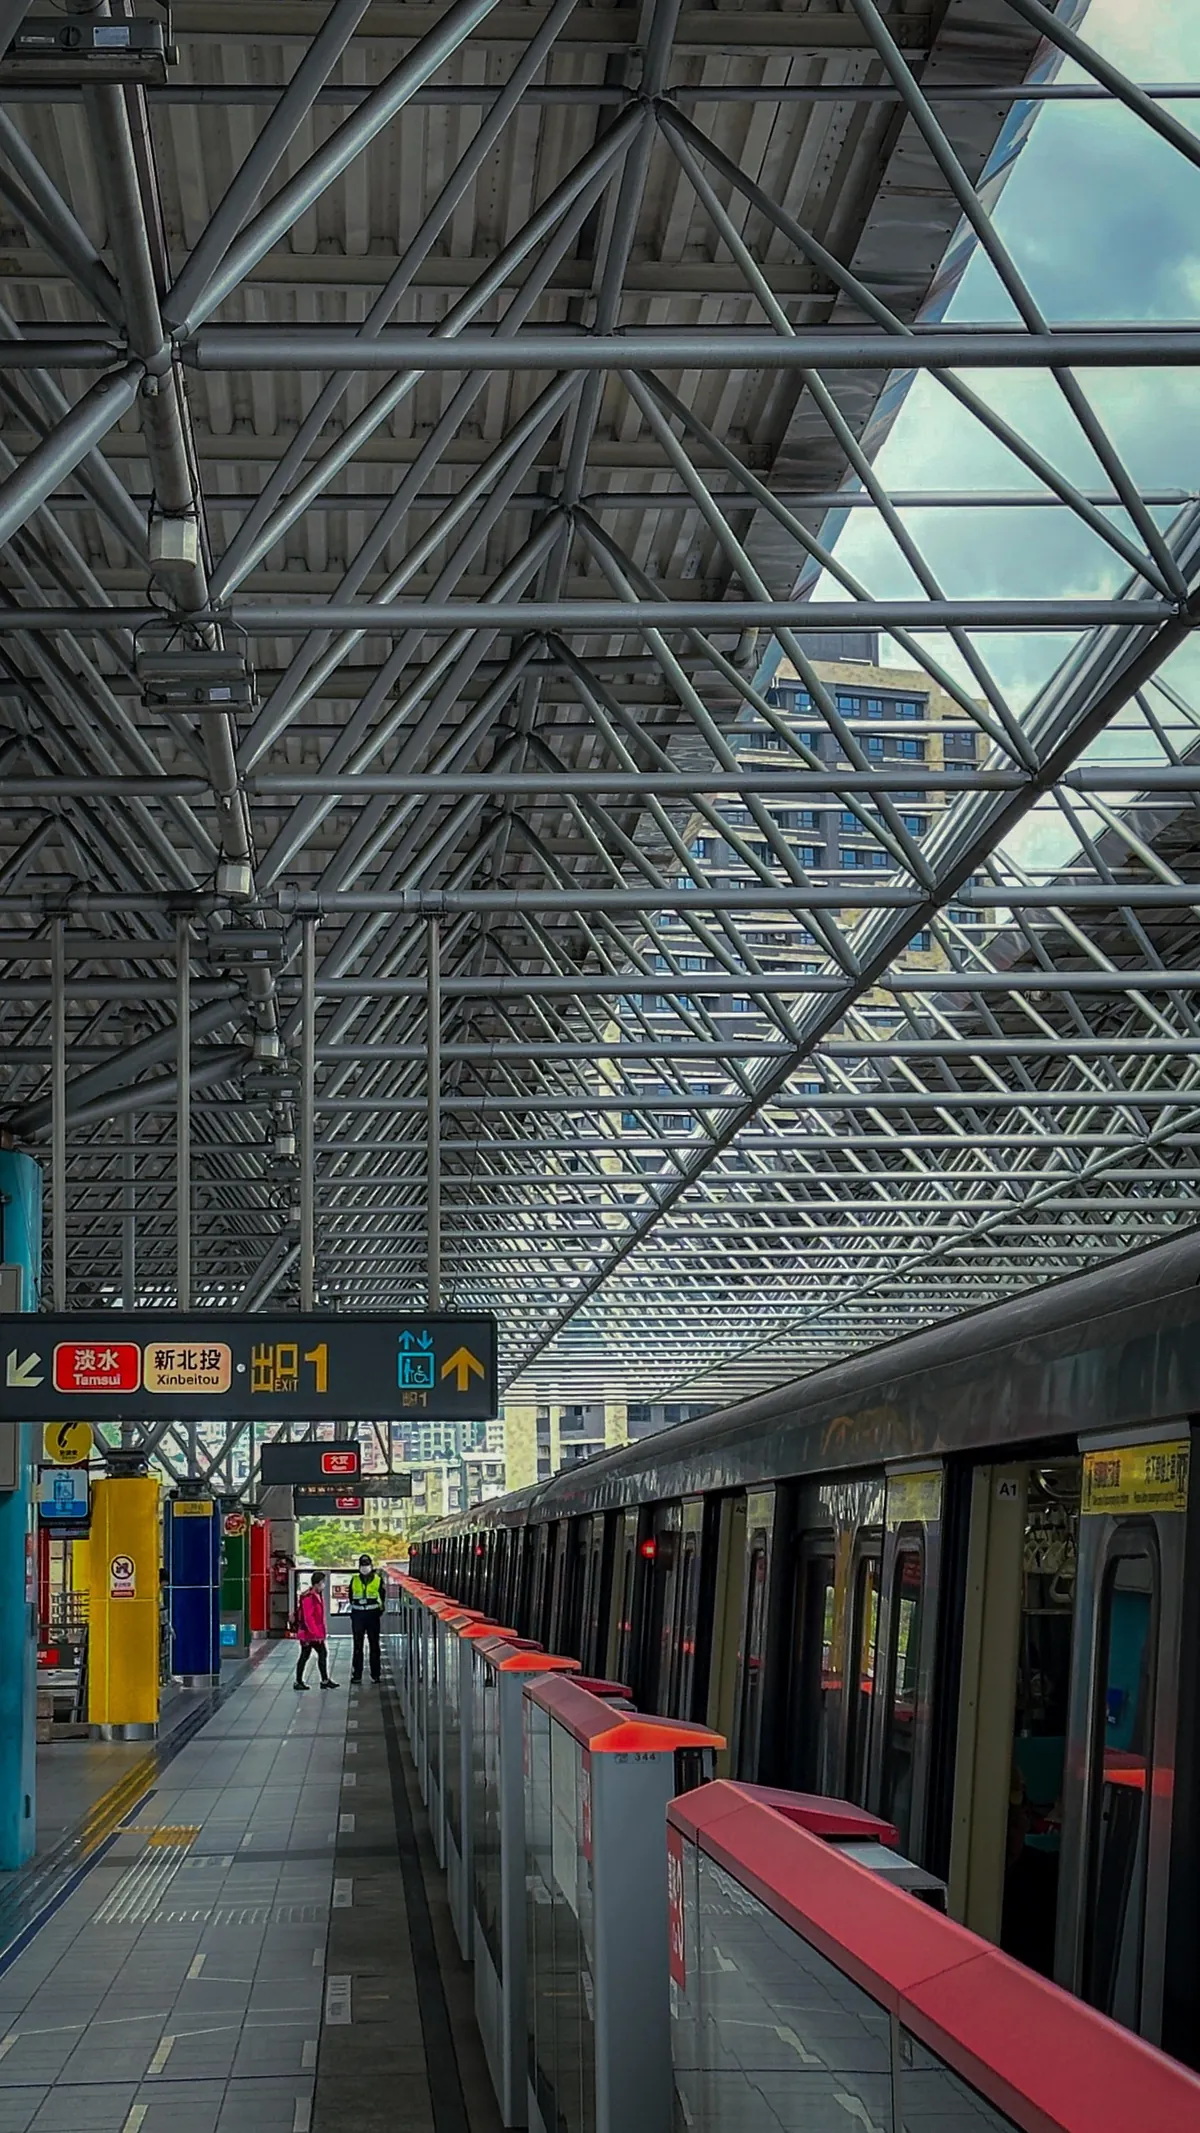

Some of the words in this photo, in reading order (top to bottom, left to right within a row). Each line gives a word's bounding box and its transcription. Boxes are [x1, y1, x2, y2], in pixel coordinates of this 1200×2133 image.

[74, 1349, 119, 1371] 淡水
[154, 1349, 222, 1370] 新北投
[251, 1343, 298, 1393] 出口
[304, 1343, 327, 1393] 1
[73, 1373, 121, 1386] Tamsui
[156, 1374, 219, 1386] Xinbeitou
[274, 1378, 299, 1392] EXIT
[999, 1482, 1016, 1496] A1
